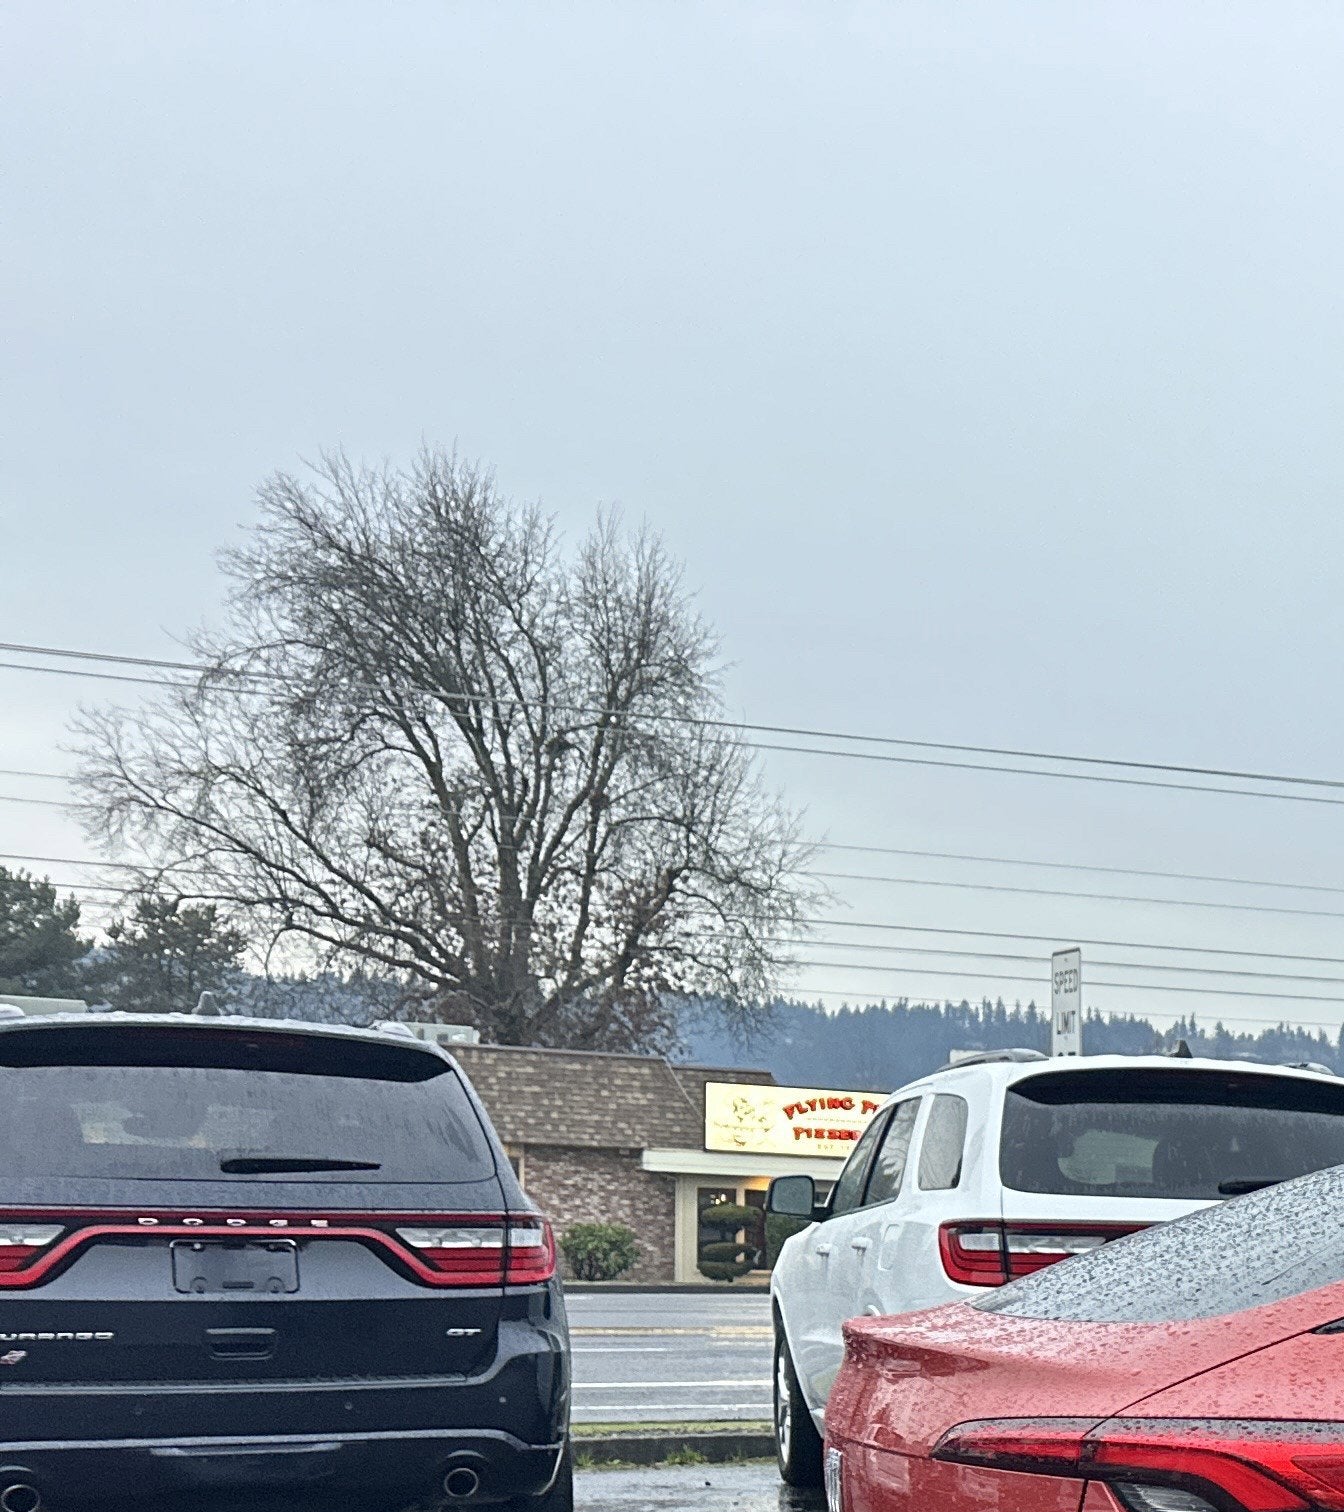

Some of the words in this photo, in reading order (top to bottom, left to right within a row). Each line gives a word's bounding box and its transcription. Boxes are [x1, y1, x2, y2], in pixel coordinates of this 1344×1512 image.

[1054, 968, 1078, 995] SPEED
[1056, 1010, 1076, 1035] LIMIT
[783, 1097, 855, 1120] FLYING
[0, 1332, 114, 1340] URANGO
